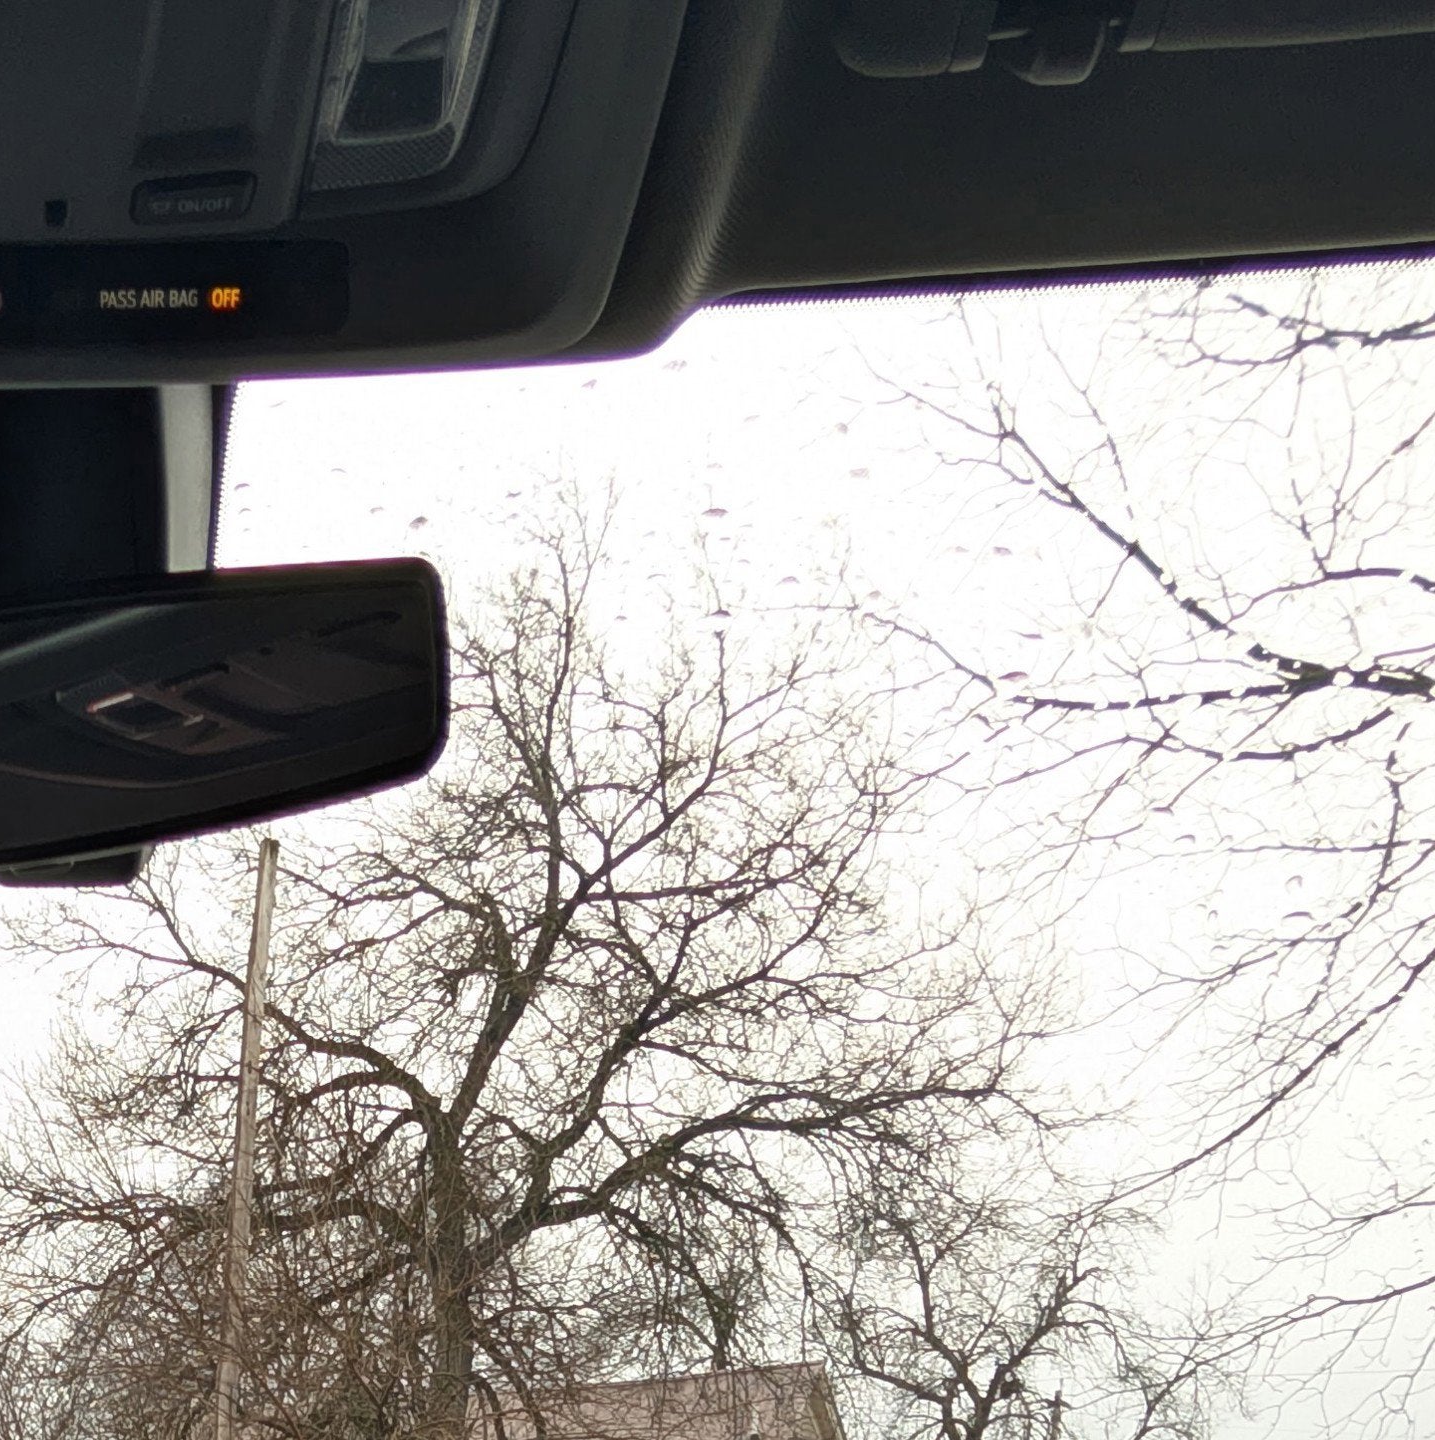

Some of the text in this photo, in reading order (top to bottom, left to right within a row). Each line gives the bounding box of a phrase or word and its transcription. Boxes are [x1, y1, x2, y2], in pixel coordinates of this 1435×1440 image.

[178, 197, 233, 213] ON/OFF
[100, 288, 241, 309] PASS AIR BAG OFF
